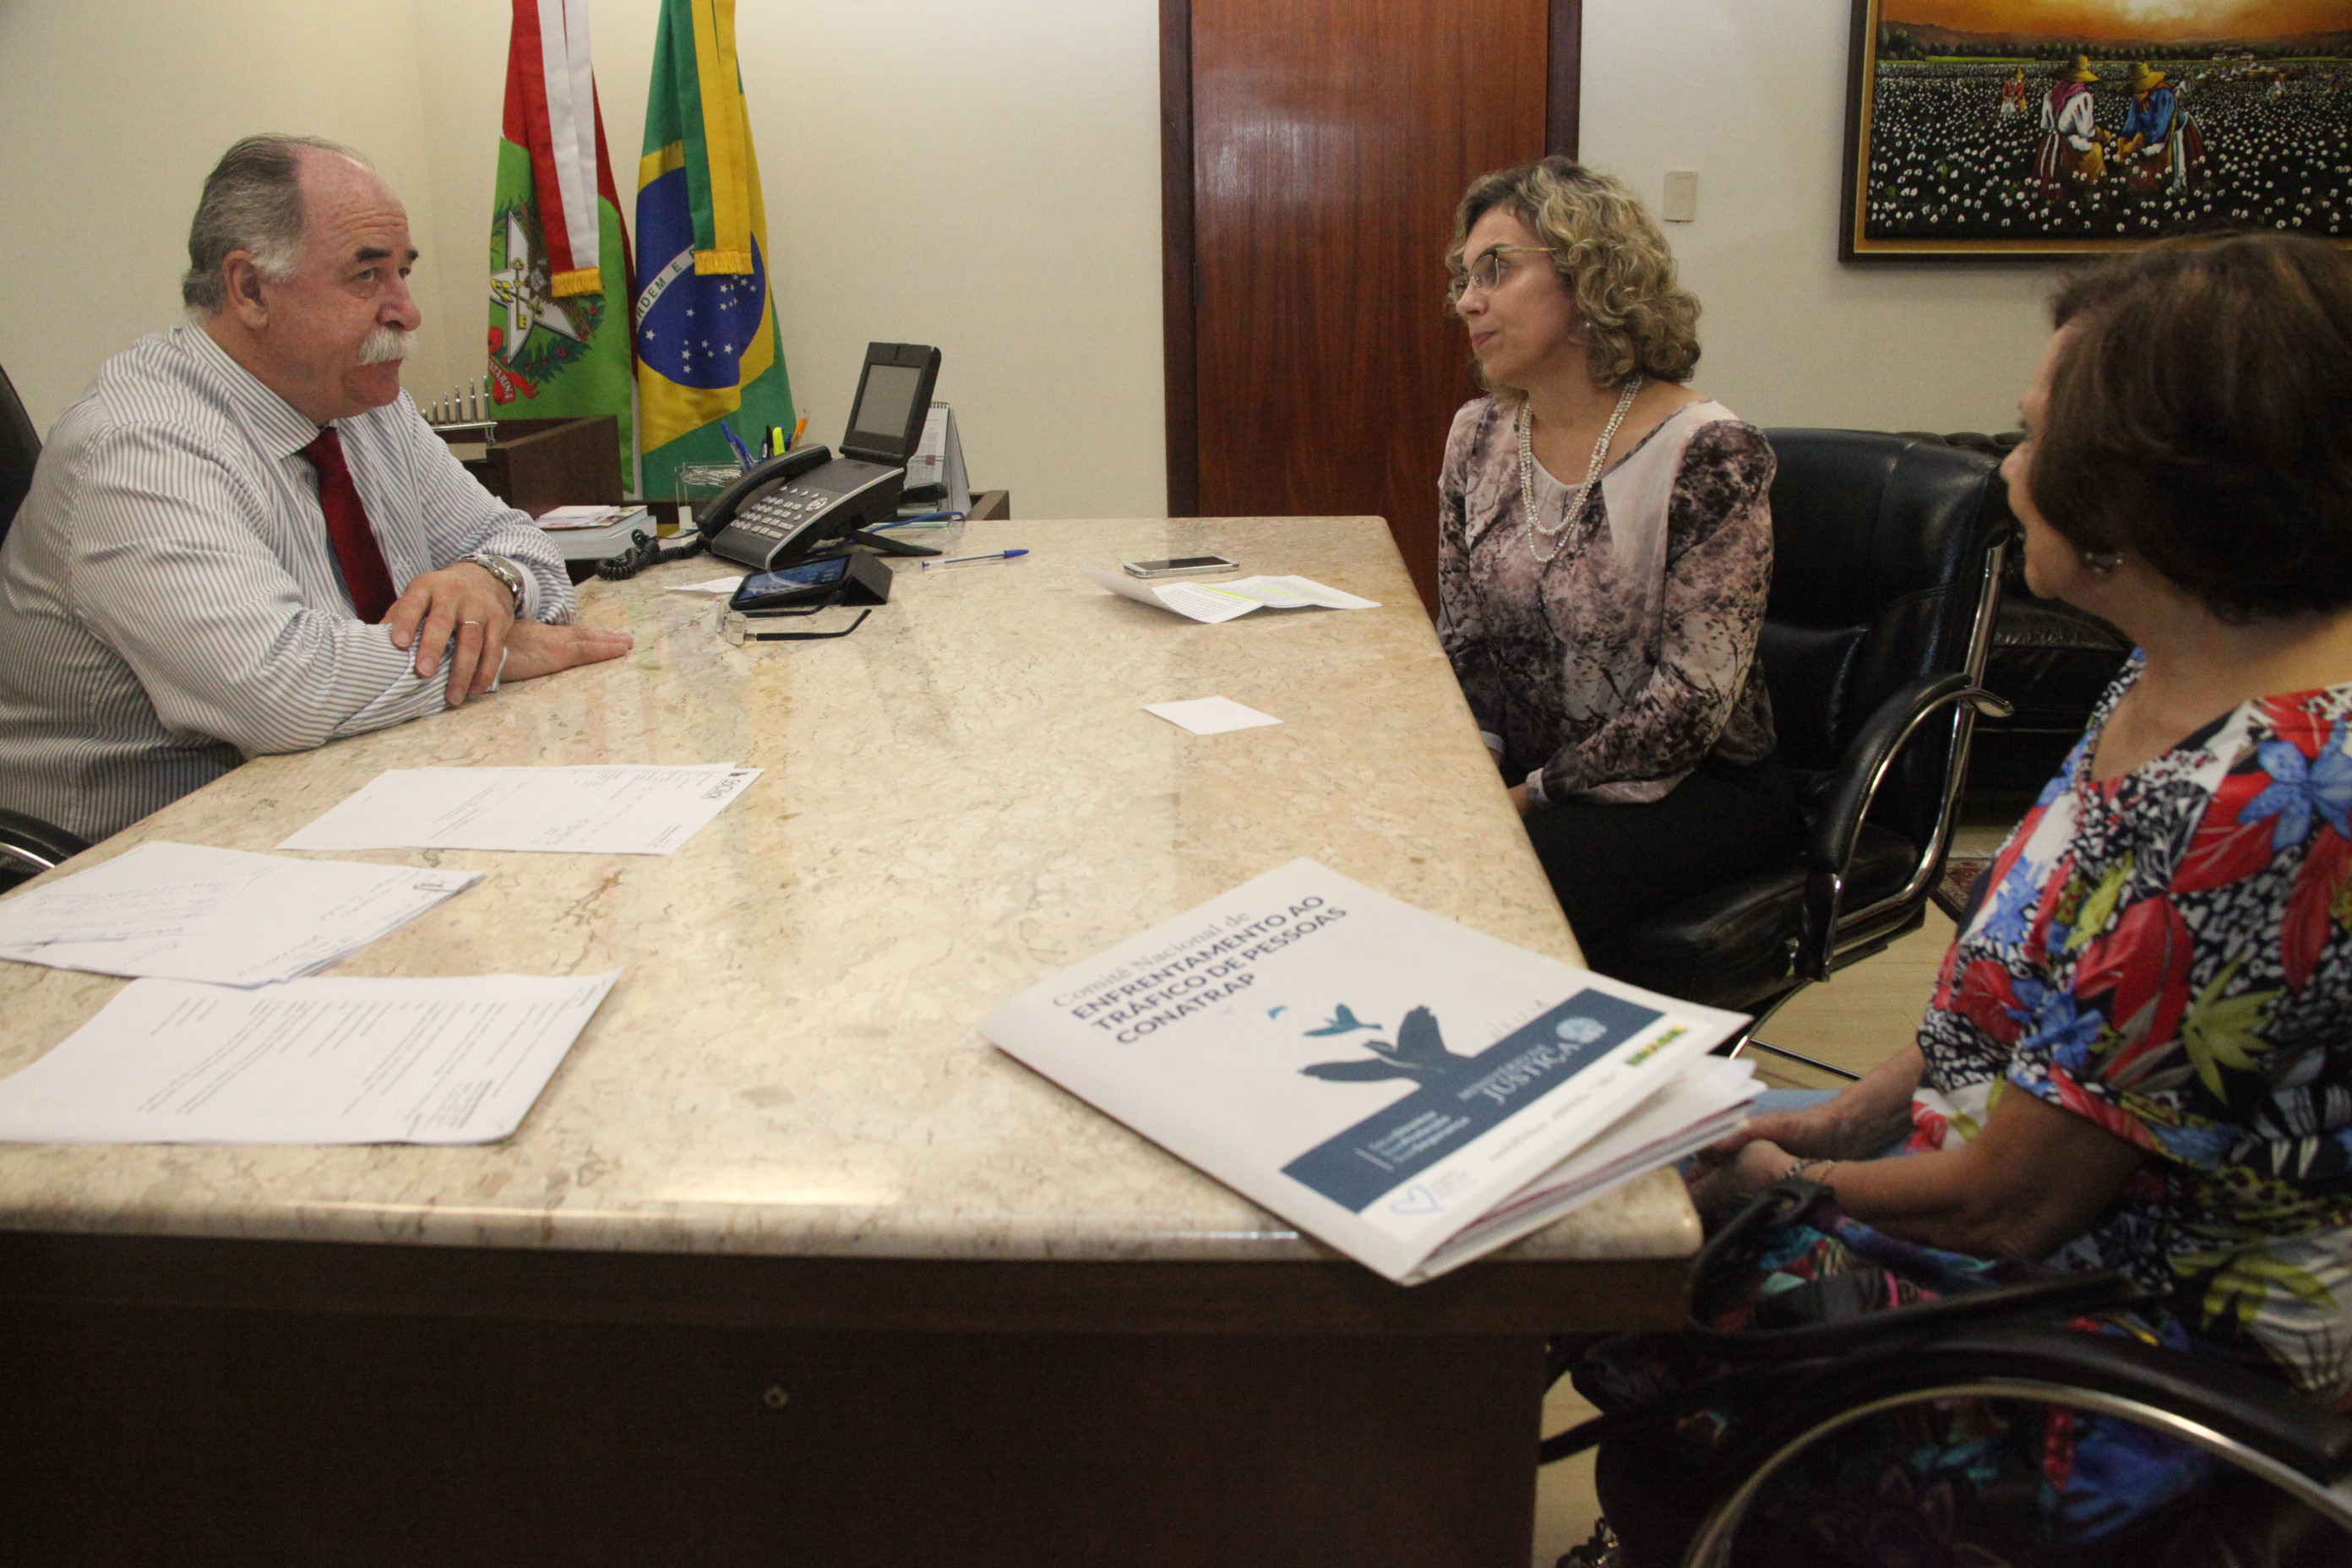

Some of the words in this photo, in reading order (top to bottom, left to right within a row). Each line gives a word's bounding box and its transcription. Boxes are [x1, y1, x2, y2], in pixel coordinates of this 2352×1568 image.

[636, 276, 667, 324] RDEM
[1054, 966, 1133, 1008] Comitê
[1131, 923, 1223, 972] Nacional
[1225, 911, 1250, 928] de
[1072, 914, 1287, 1020] ENFRENTAMENTO
[1288, 896, 1324, 917] AO
[1091, 975, 1207, 1032] TRÁFICO
[1207, 958, 1245, 979] DE
[1242, 906, 1347, 961] PESSOAS
[1116, 972, 1255, 1044] CONATRAP
